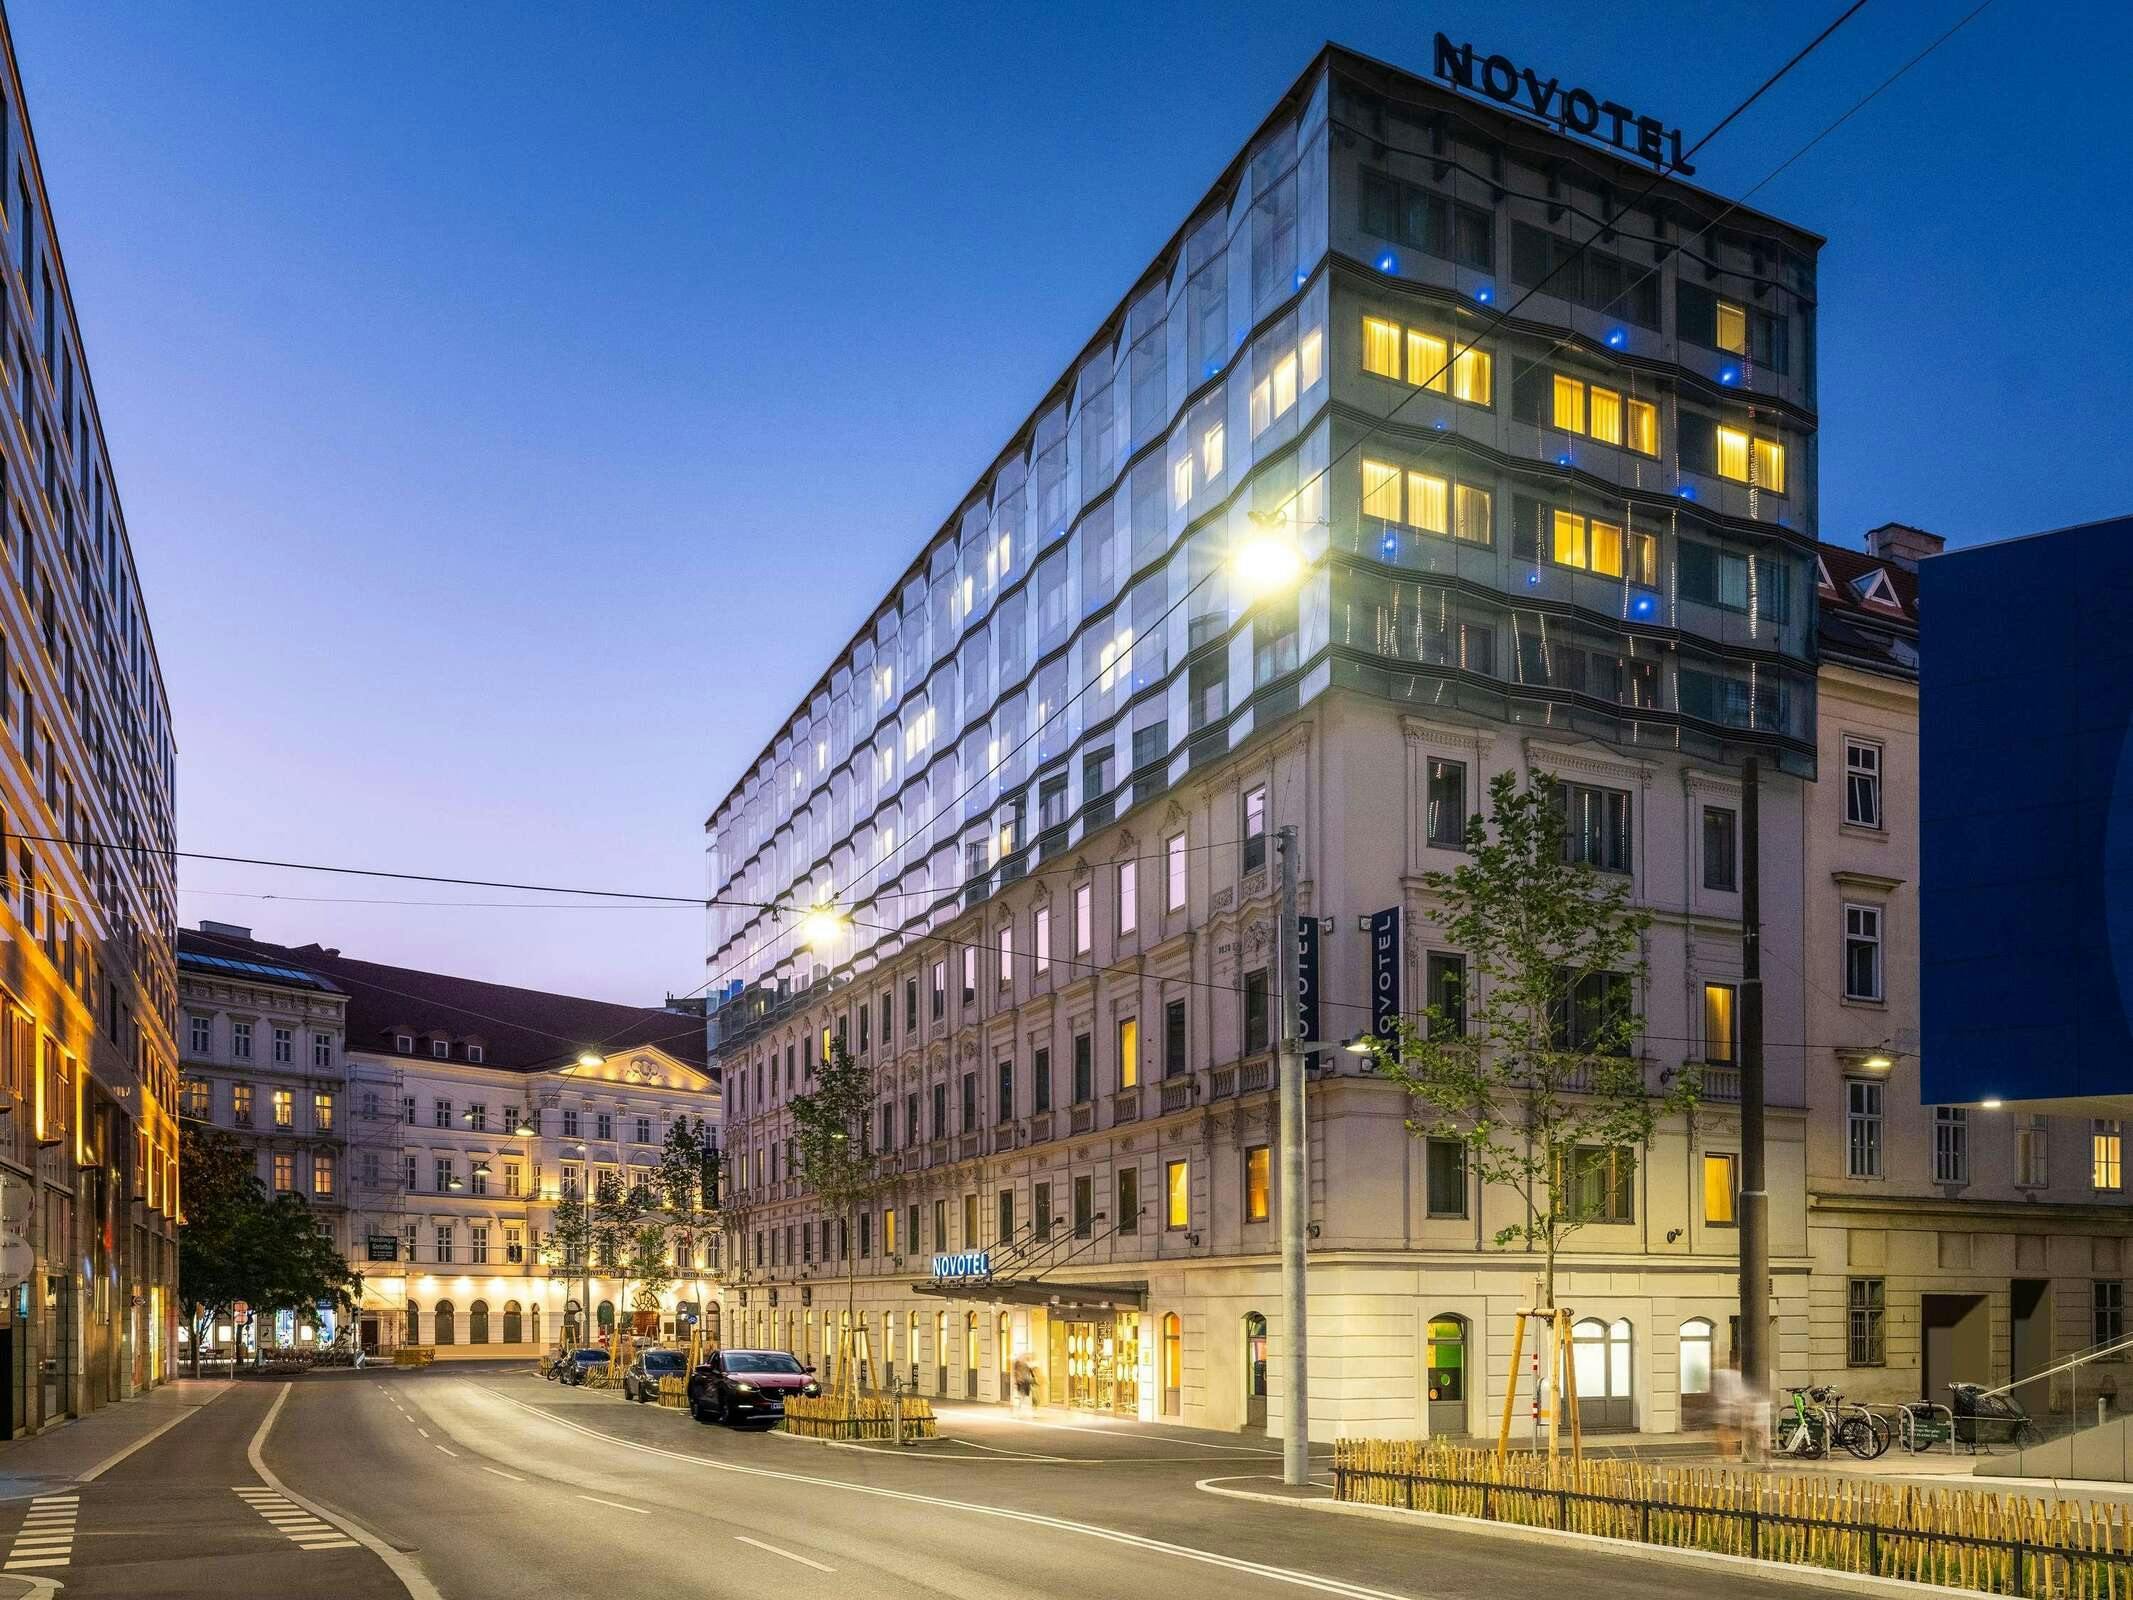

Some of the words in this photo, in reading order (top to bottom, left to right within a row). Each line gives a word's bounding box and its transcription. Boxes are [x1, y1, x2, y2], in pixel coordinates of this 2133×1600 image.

[1433, 32, 1696, 176] NOVOTEL
[1379, 914, 1391, 1034] OVOTEL
[934, 1253, 987, 1276] NOVOTEL
